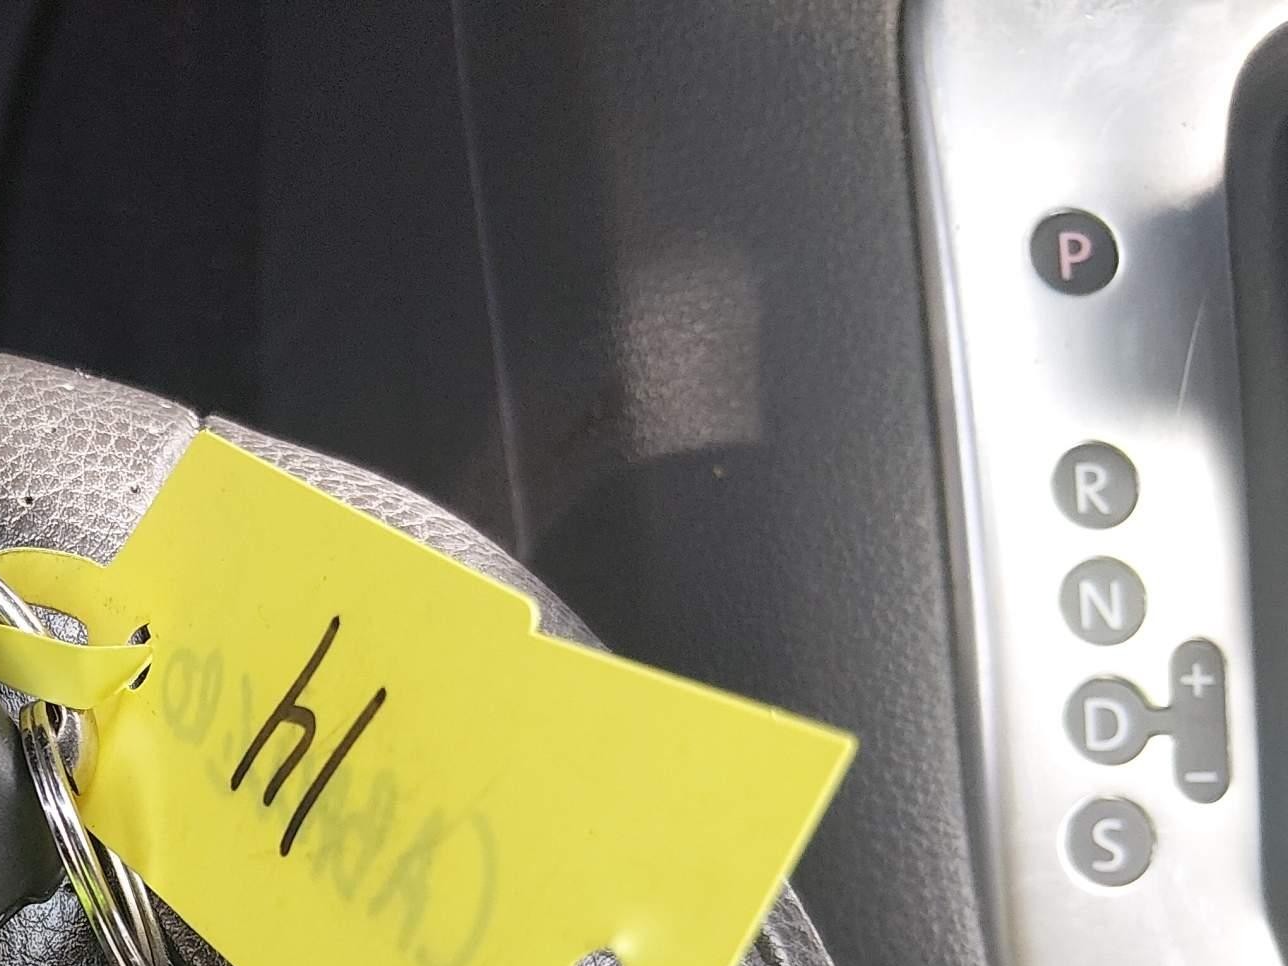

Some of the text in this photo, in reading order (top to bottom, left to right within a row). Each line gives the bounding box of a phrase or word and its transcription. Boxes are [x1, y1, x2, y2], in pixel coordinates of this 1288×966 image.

[1058, 231, 1092, 281] P
[1074, 461, 1111, 515] R
[1078, 578, 1125, 631] N
[1083, 697, 1129, 752] D
[1091, 817, 1127, 873] S
